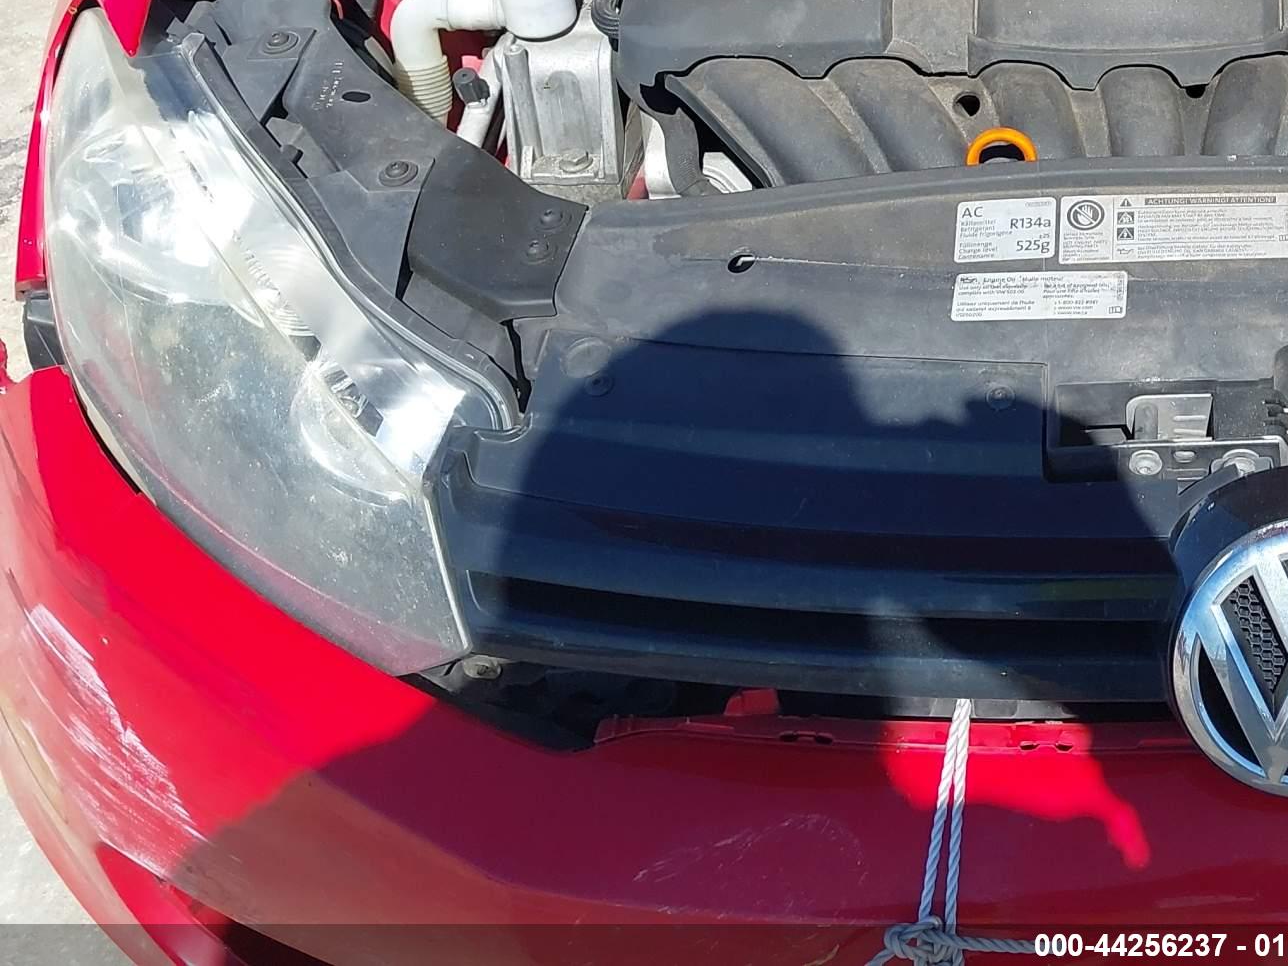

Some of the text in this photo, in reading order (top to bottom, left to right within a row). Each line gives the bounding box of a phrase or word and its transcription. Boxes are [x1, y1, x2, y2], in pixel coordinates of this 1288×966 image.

[962, 206, 984, 219] AC
[1010, 217, 1052, 230] R134a
[1016, 240, 1050, 254] 525g
